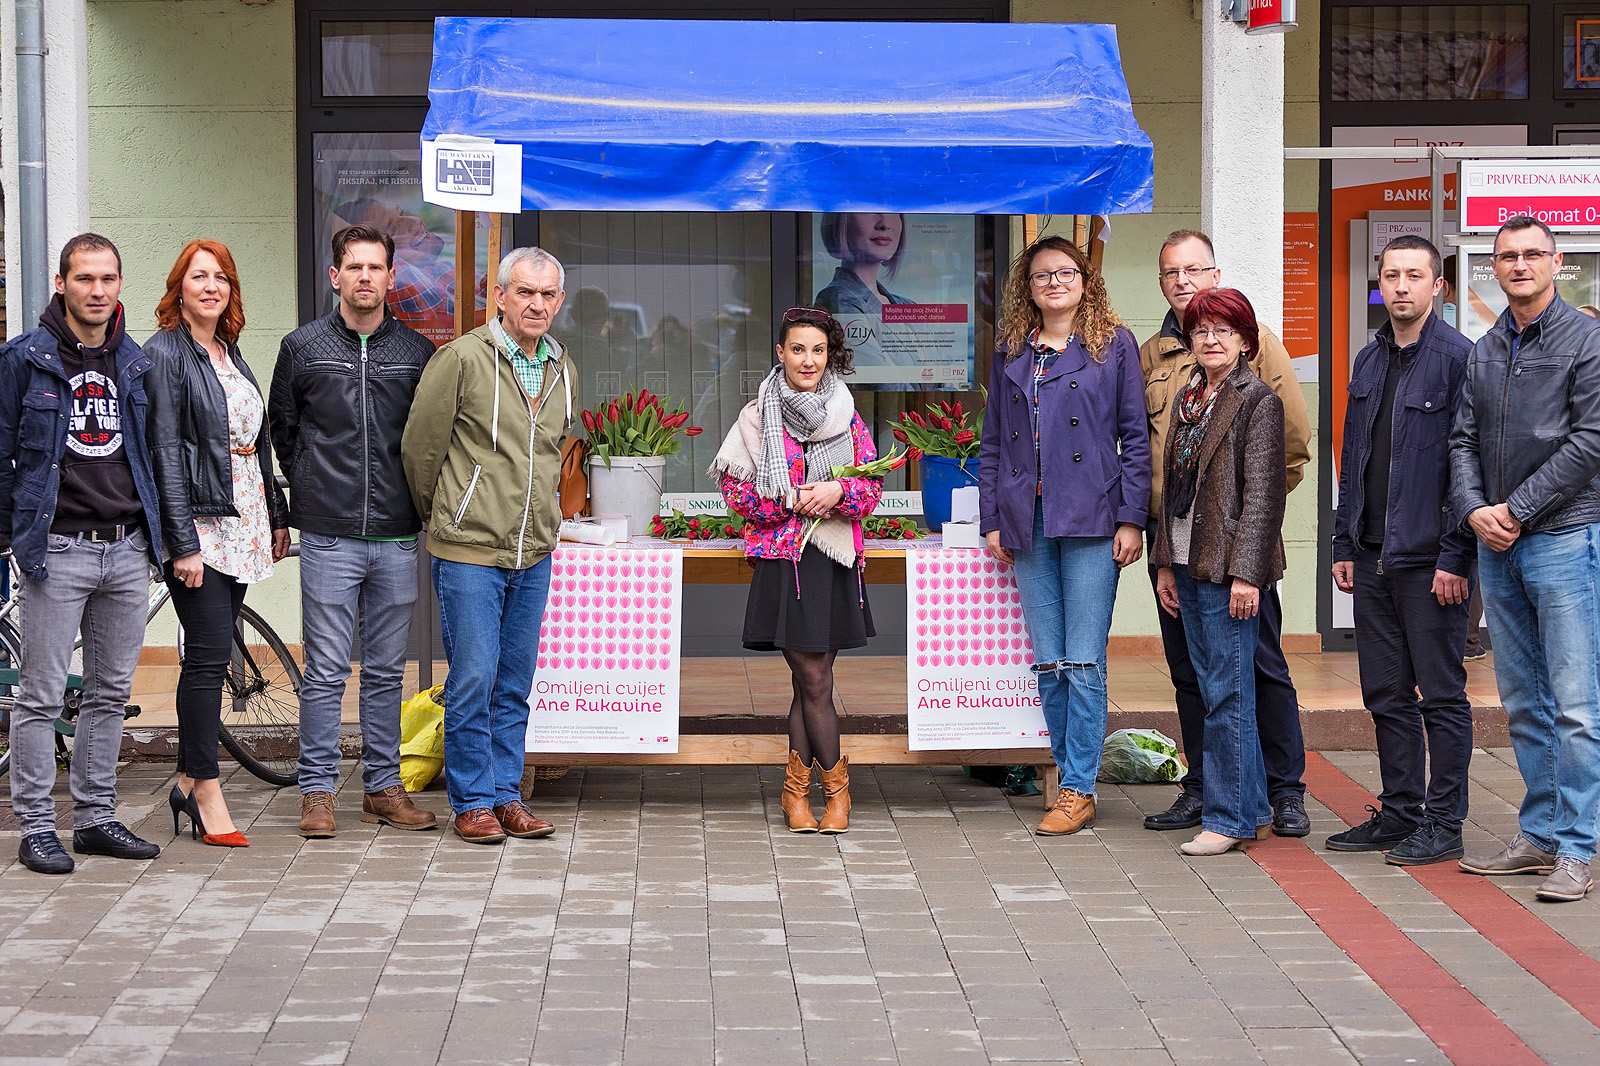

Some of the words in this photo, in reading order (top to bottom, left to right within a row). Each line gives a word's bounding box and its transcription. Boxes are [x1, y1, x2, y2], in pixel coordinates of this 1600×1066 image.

[1487, 174, 1556, 184] PRIVREDNA
[1384, 189, 1456, 200] BANKM
[1473, 272, 1488, 280] ŠTO
[71, 398, 119, 416] LFIGE
[69, 416, 86, 430] EW
[660, 500, 669, 509] SA
[689, 500, 727, 509] SANPAO
[878, 499, 908, 508] NTESA
[536, 681, 610, 698] Omiljeni
[616, 682, 665, 698] cvijet
[918, 677, 990, 694] Omiljeni
[996, 677, 1037, 692] cvije
[535, 698, 569, 711] Ane
[576, 699, 662, 712] Rukavine
[918, 696, 951, 709] Ane
[957, 694, 1042, 708] Rukavine
